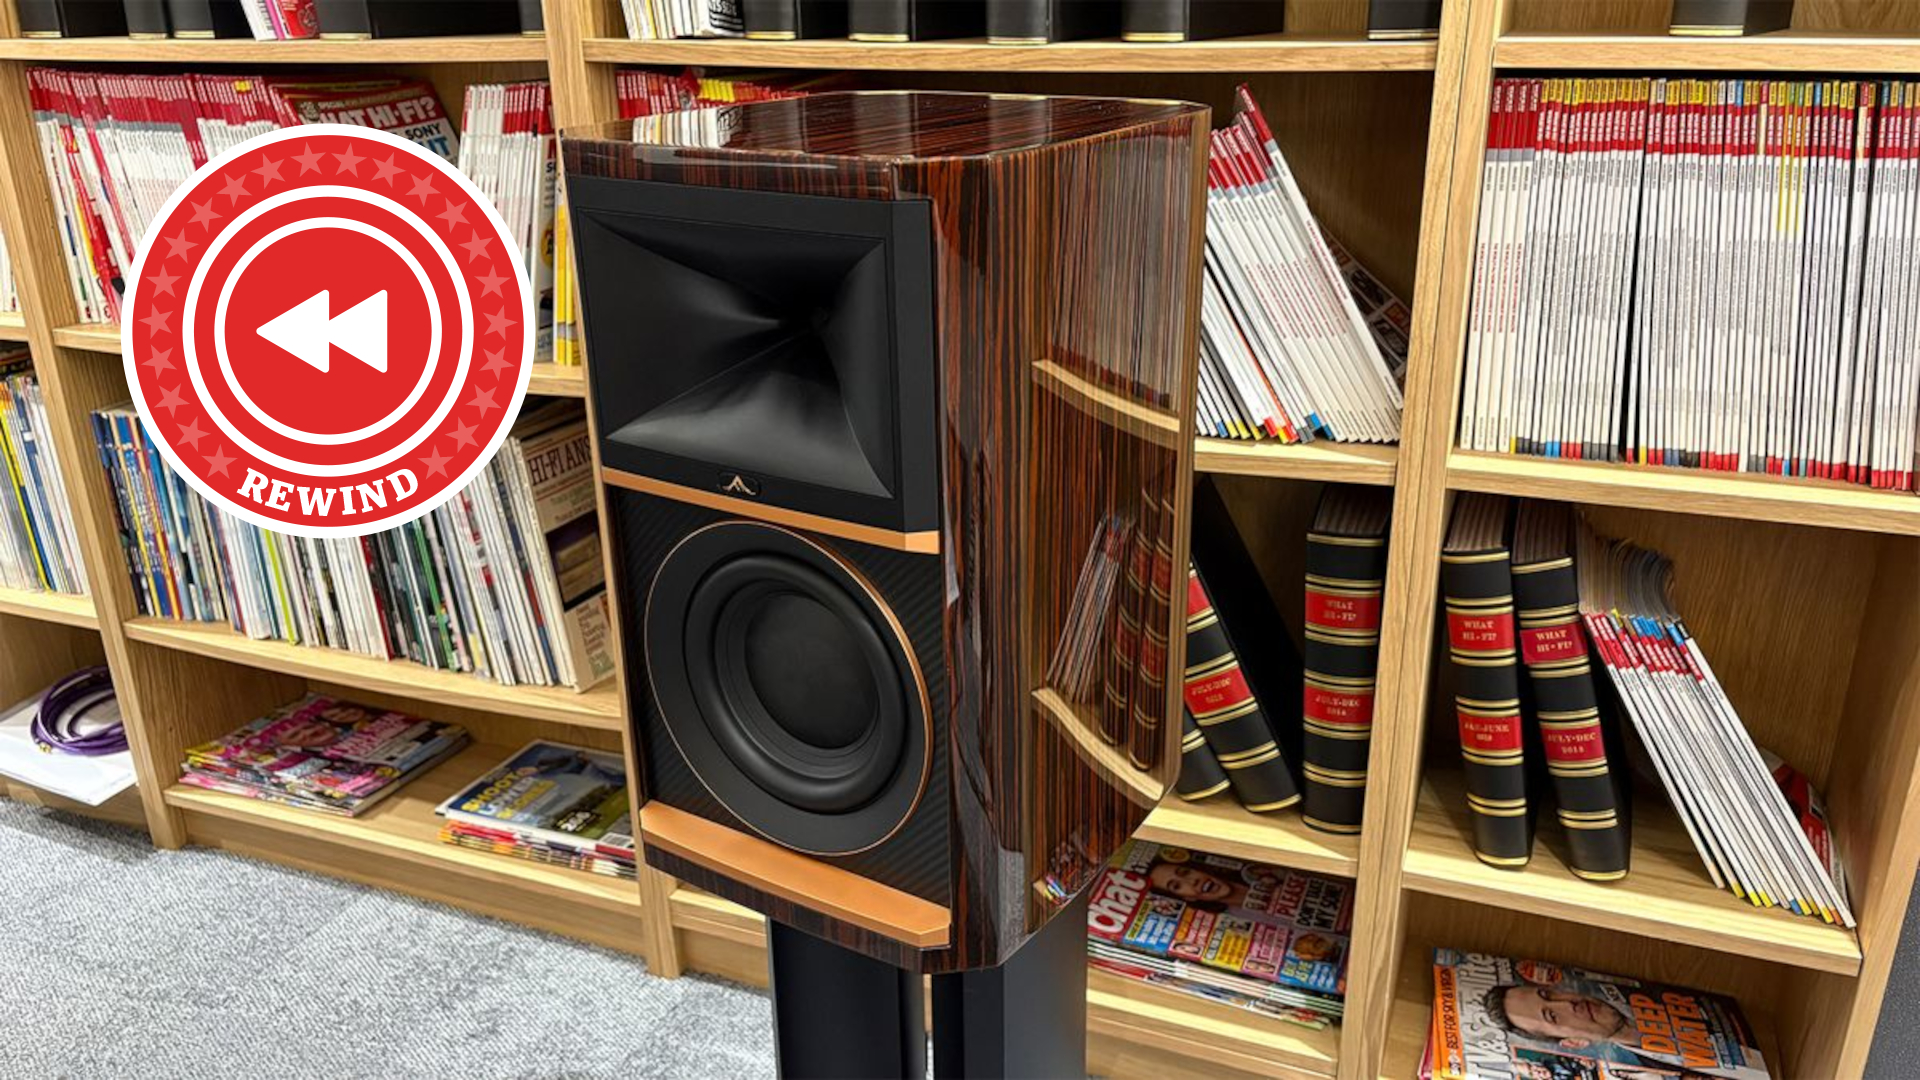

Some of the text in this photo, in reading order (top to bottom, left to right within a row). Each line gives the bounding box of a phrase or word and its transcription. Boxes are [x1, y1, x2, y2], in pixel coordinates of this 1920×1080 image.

[404, 122, 441, 140] SONY
[1463, 620, 1494, 630] WHAT
[1536, 629, 1568, 641] WHAT
[1443, 1014, 1457, 1031] FOR
[1629, 993, 1679, 1056] DEEP
[1662, 991, 1719, 1068] WATER
[1445, 1031, 1459, 1050] BEST
